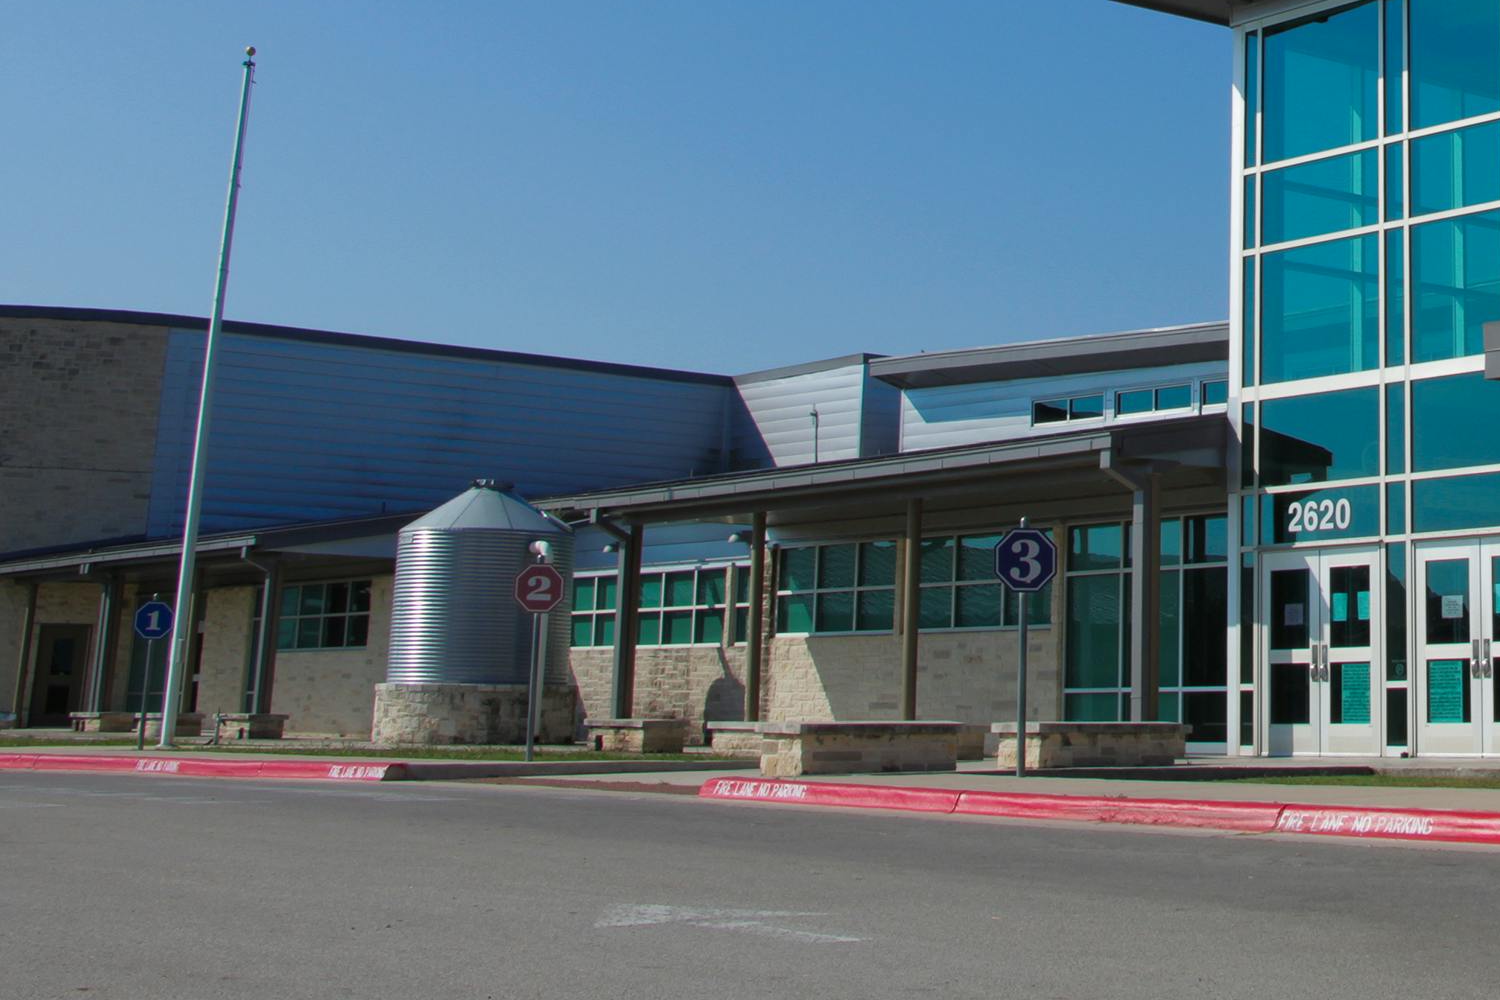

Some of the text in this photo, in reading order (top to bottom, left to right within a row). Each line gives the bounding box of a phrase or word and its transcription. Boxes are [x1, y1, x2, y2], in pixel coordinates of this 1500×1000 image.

[1287, 497, 1351, 533] 2620
[1009, 538, 1042, 583] 3
[526, 575, 552, 601] 2
[145, 610, 161, 631] 1
[1276, 810, 1309, 831] FIRE
[1351, 815, 1372, 833] NO
[1374, 816, 1434, 835] PARKING
